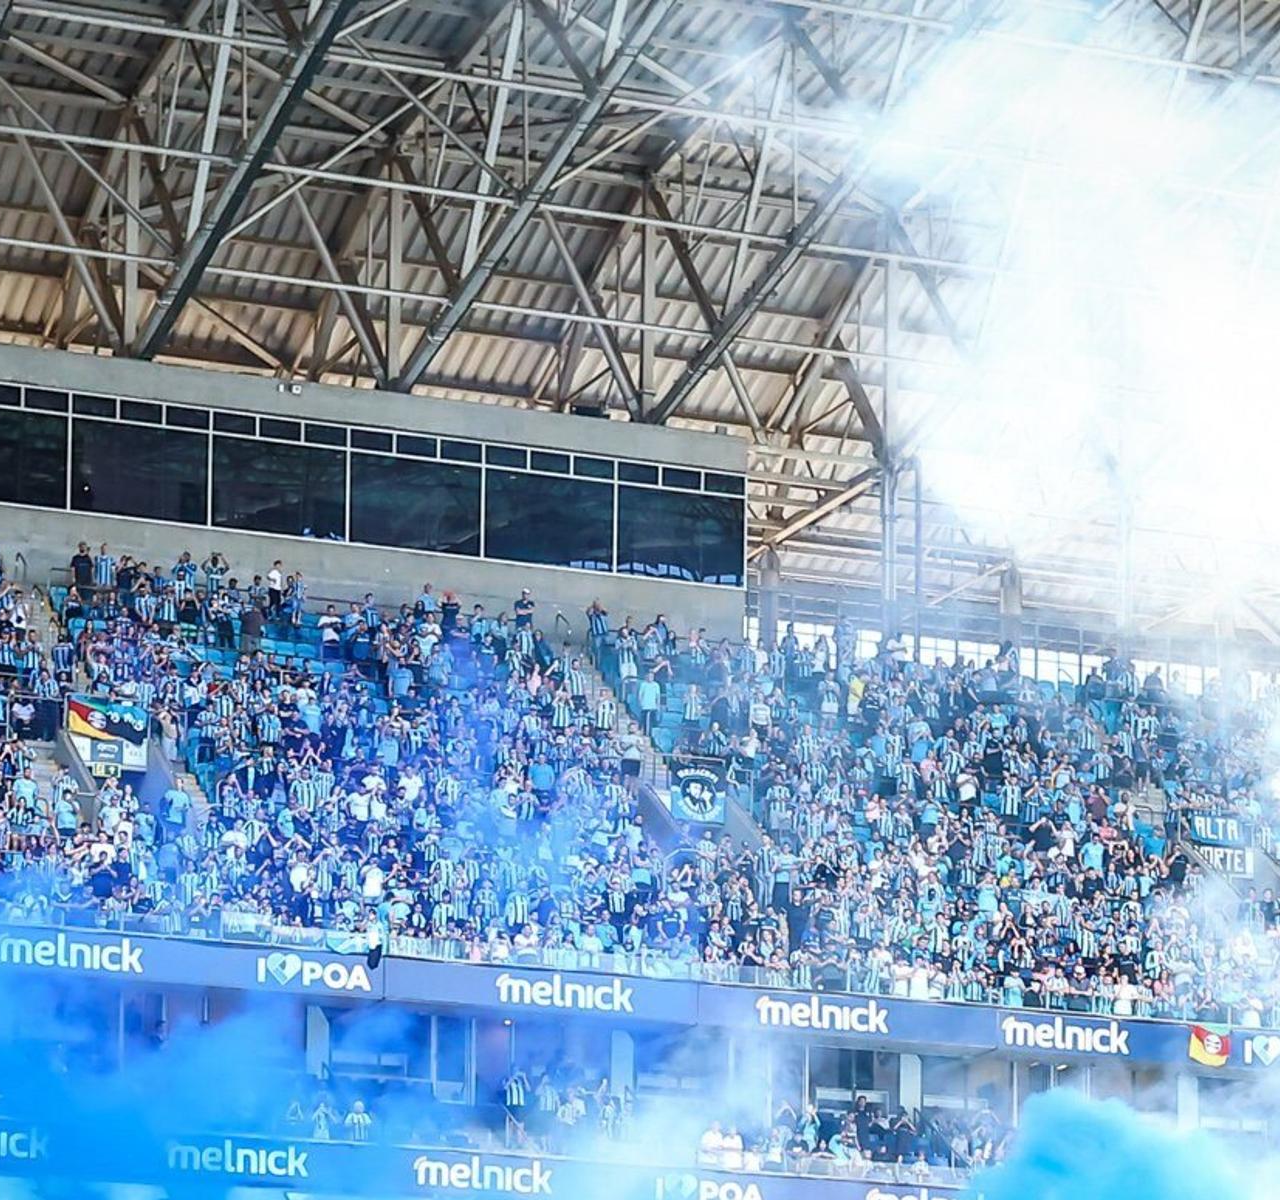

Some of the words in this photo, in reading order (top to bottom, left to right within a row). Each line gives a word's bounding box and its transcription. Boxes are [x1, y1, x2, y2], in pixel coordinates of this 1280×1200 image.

[1194, 815, 1238, 841] ALTA
[1197, 845, 1244, 873] ORTE
[302, 962, 372, 992] POA
[496, 973, 634, 1013] melnick
[756, 995, 889, 1035] melnick
[1001, 1015, 1129, 1056] melnick
[167, 1138, 309, 1179] melnick
[414, 1154, 552, 1195] melnick
